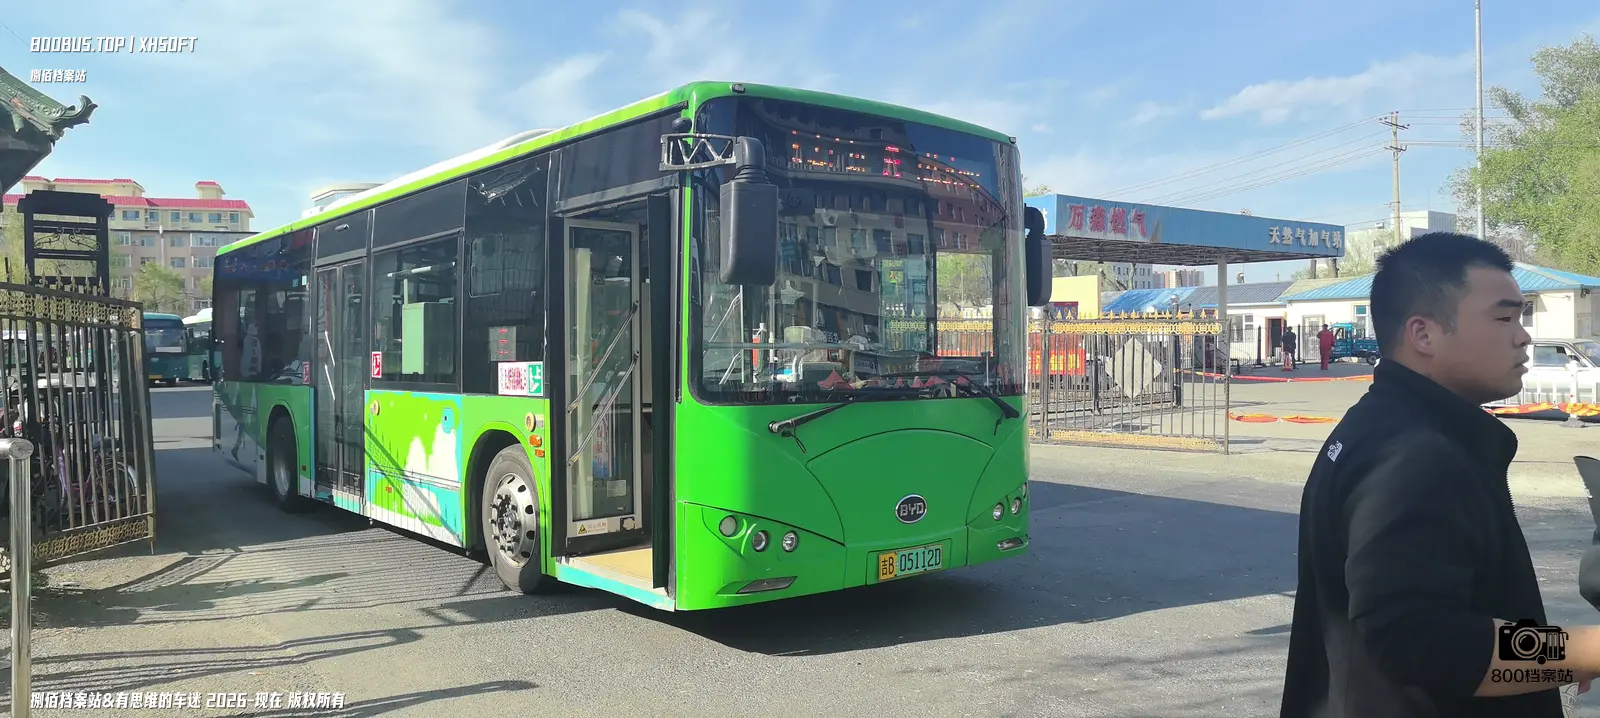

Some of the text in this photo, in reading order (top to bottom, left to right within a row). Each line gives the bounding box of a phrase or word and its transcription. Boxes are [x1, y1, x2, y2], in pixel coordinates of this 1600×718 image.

[1268, 225, 1342, 249] 天然气加气站
[900, 502, 924, 517] BYD
